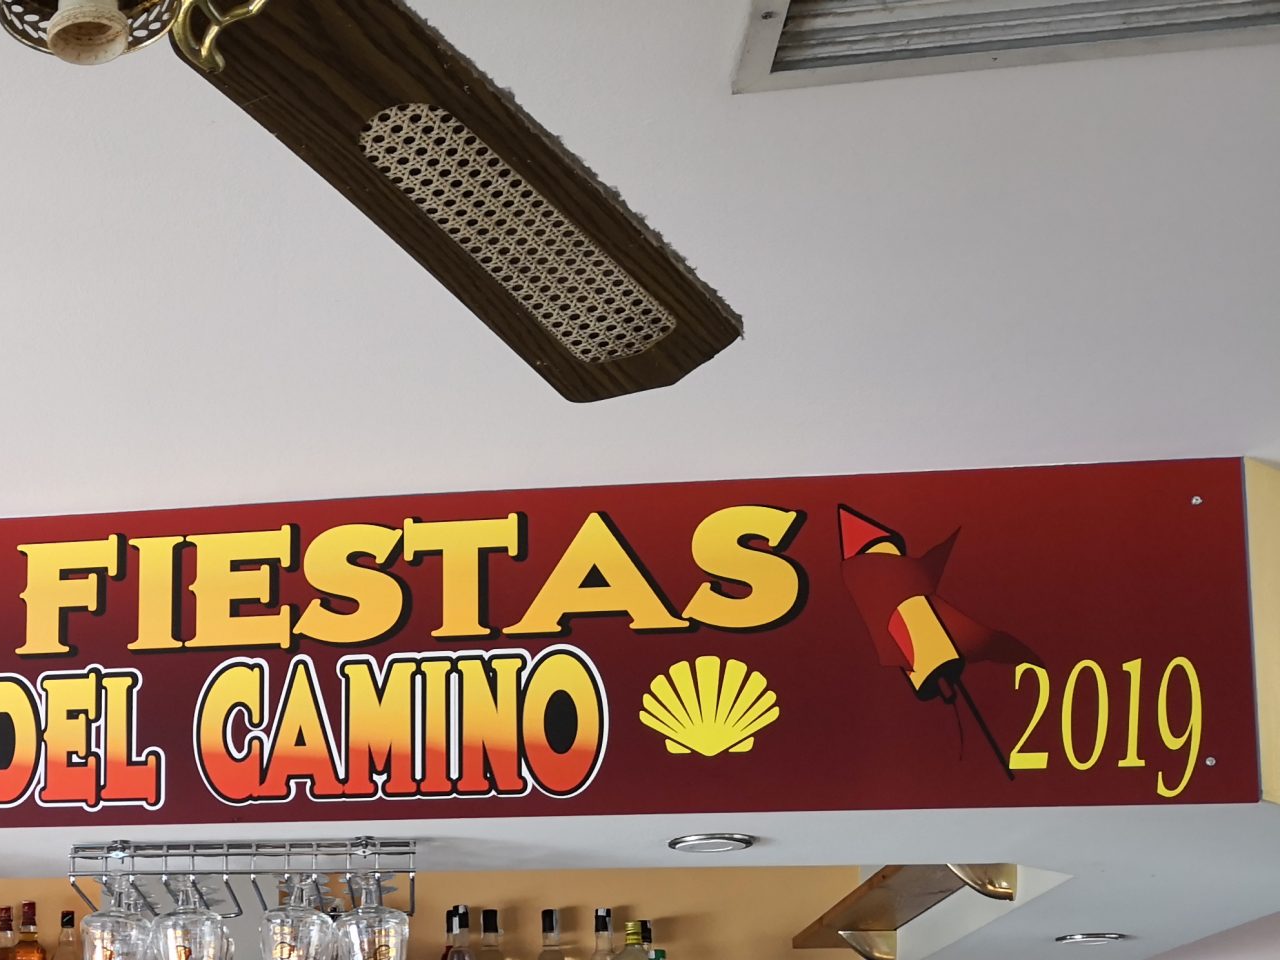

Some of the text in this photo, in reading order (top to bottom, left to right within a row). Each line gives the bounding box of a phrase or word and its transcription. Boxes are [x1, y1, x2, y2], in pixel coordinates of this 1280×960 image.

[16, 504, 809, 659] FIESTAS
[193, 643, 610, 808] CAMINO
[1009, 655, 1206, 799] 2019
